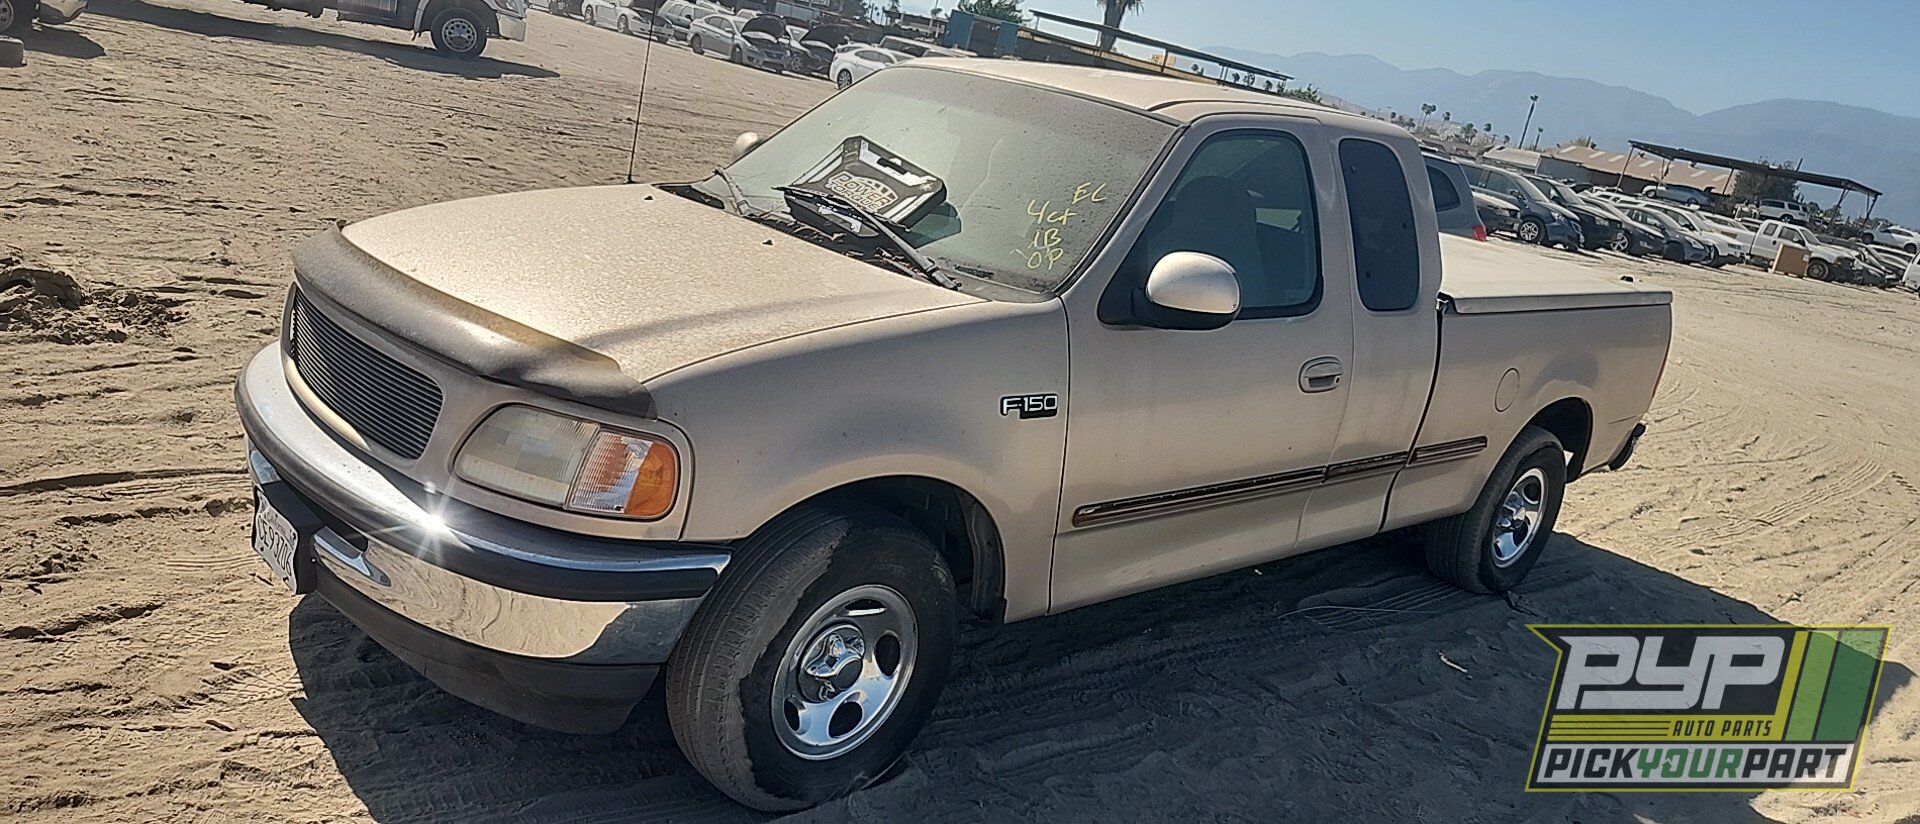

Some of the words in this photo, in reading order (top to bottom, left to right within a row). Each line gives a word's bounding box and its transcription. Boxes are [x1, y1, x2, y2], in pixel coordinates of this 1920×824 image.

[827, 181, 880, 211] TORQUE
[830, 172, 894, 207] POWER
[1002, 395, 1058, 415] F-150
